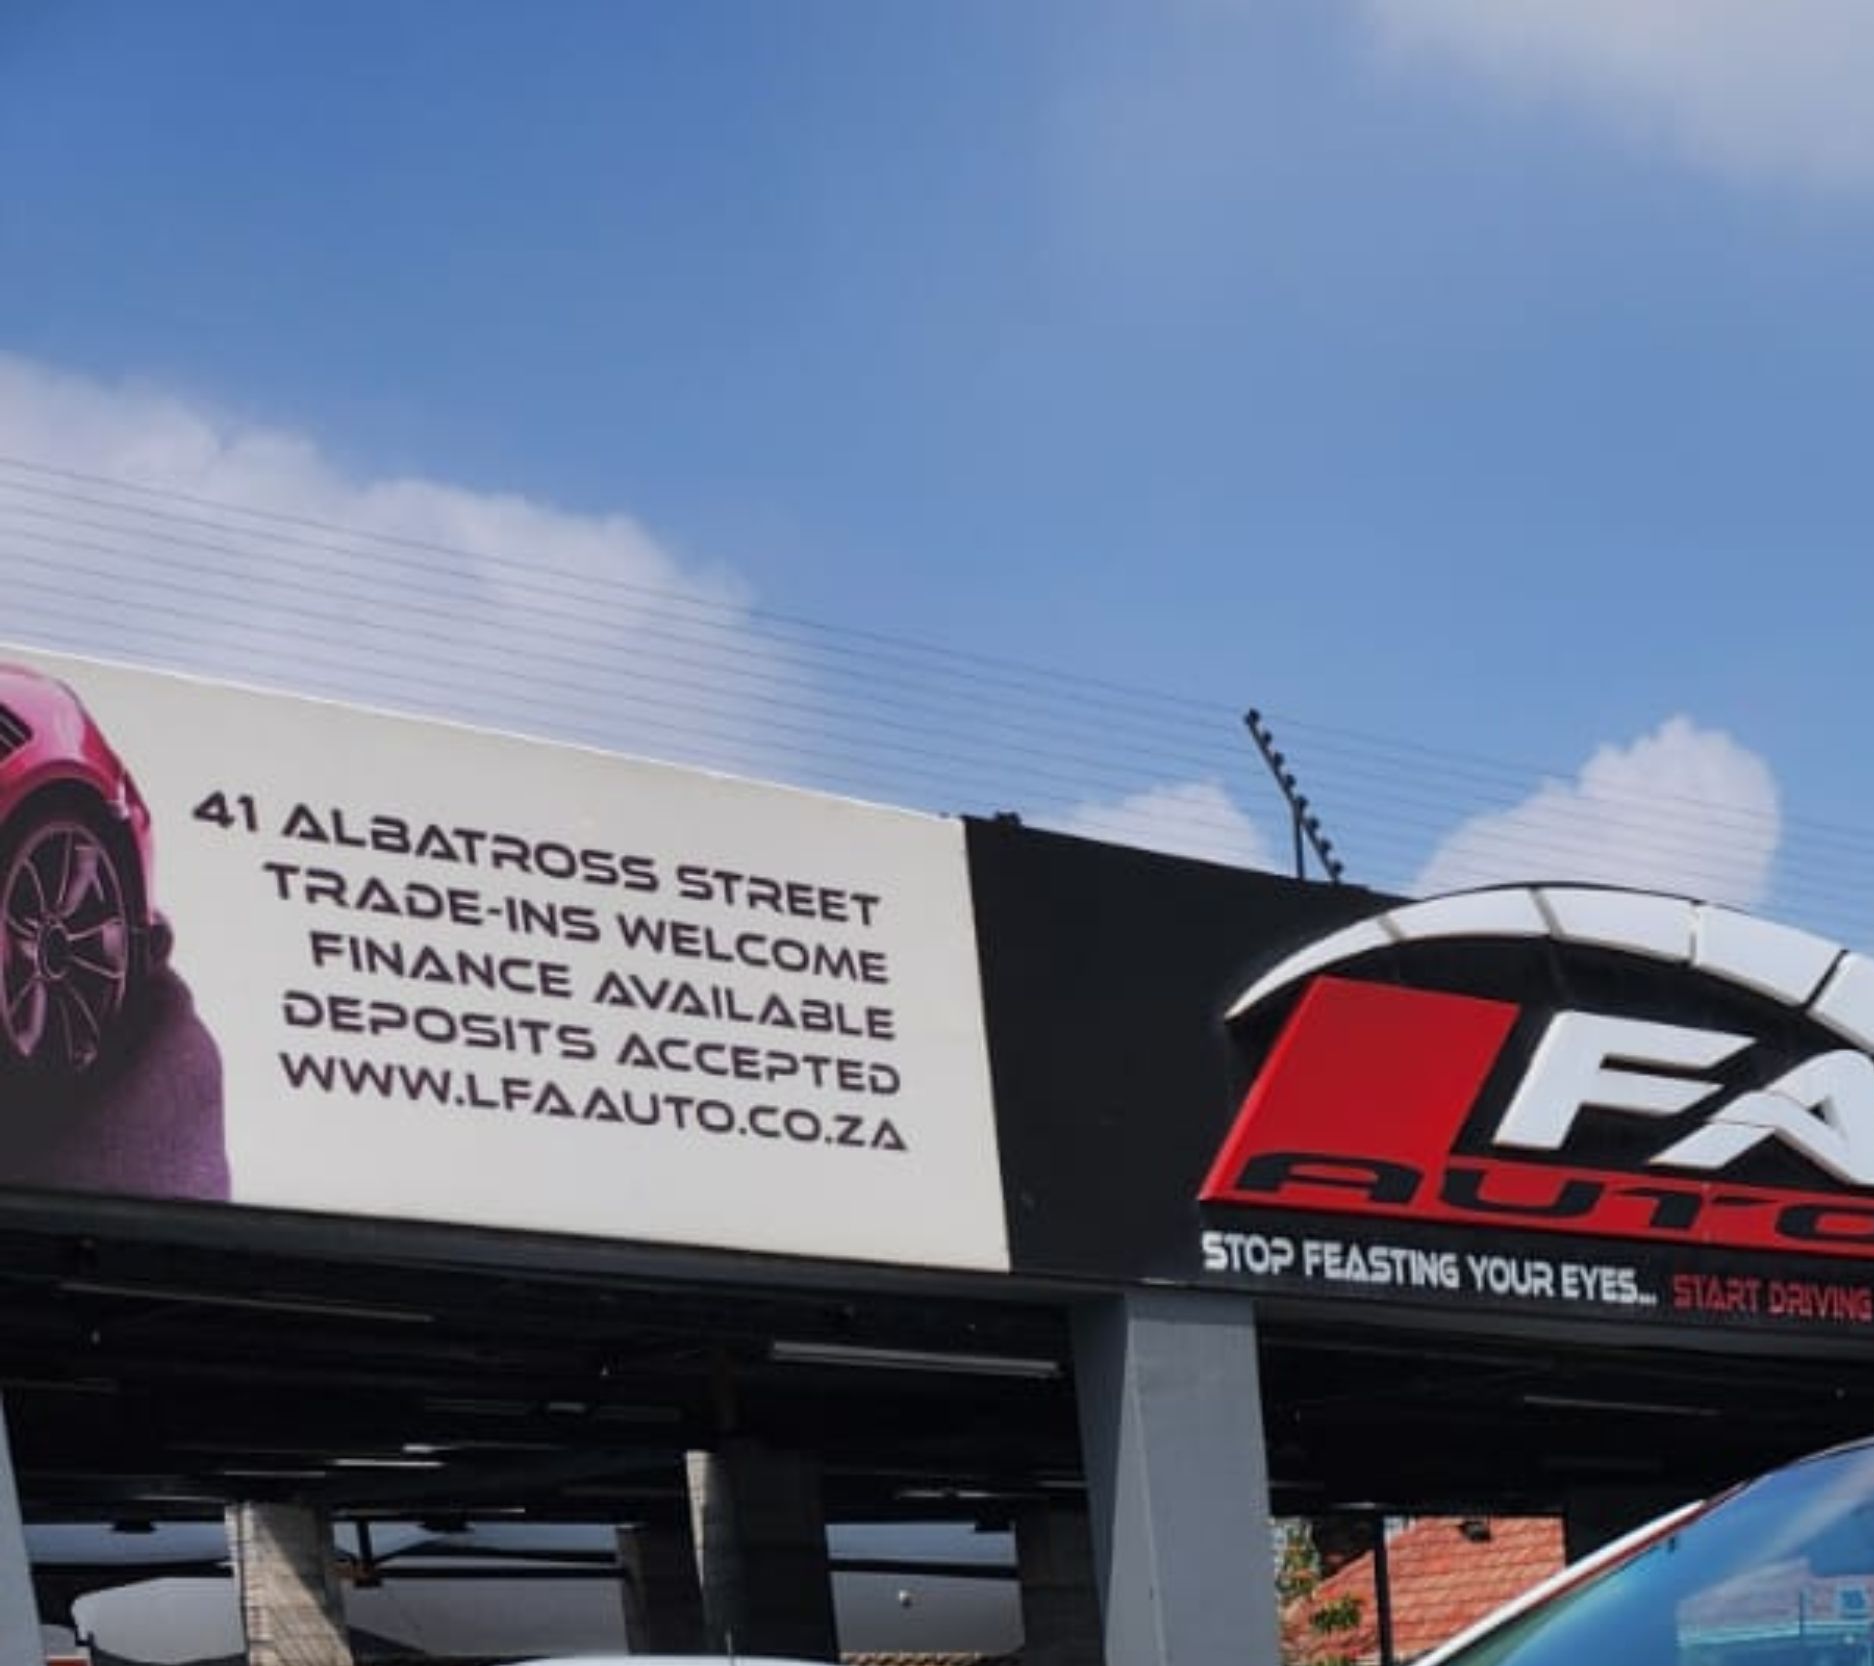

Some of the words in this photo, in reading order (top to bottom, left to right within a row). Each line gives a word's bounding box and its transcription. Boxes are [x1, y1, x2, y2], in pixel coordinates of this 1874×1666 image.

[192, 791, 259, 833] 41
[281, 803, 661, 893] ALBATROSS
[676, 864, 881, 926] STREET
[263, 861, 601, 943] TRADE-INS
[616, 913, 890, 985] WELCOME
[309, 930, 572, 999] FINANCE
[593, 971, 896, 1041] AVAILABLE
[283, 990, 597, 1060] DEPOSITS
[616, 1033, 902, 1095] ACCEPTED
[279, 1052, 908, 1151] WWW.LFAAUTO.CO.ZA
[1201, 1231, 1294, 1275] STOP
[1303, 1241, 1460, 1289] FEASTING
[1467, 1255, 1554, 1297] YOUR
[1561, 1264, 1657, 1305] EYES...
[1672, 1273, 1761, 1312] START
[1769, 1280, 1873, 1322] DRIVING
